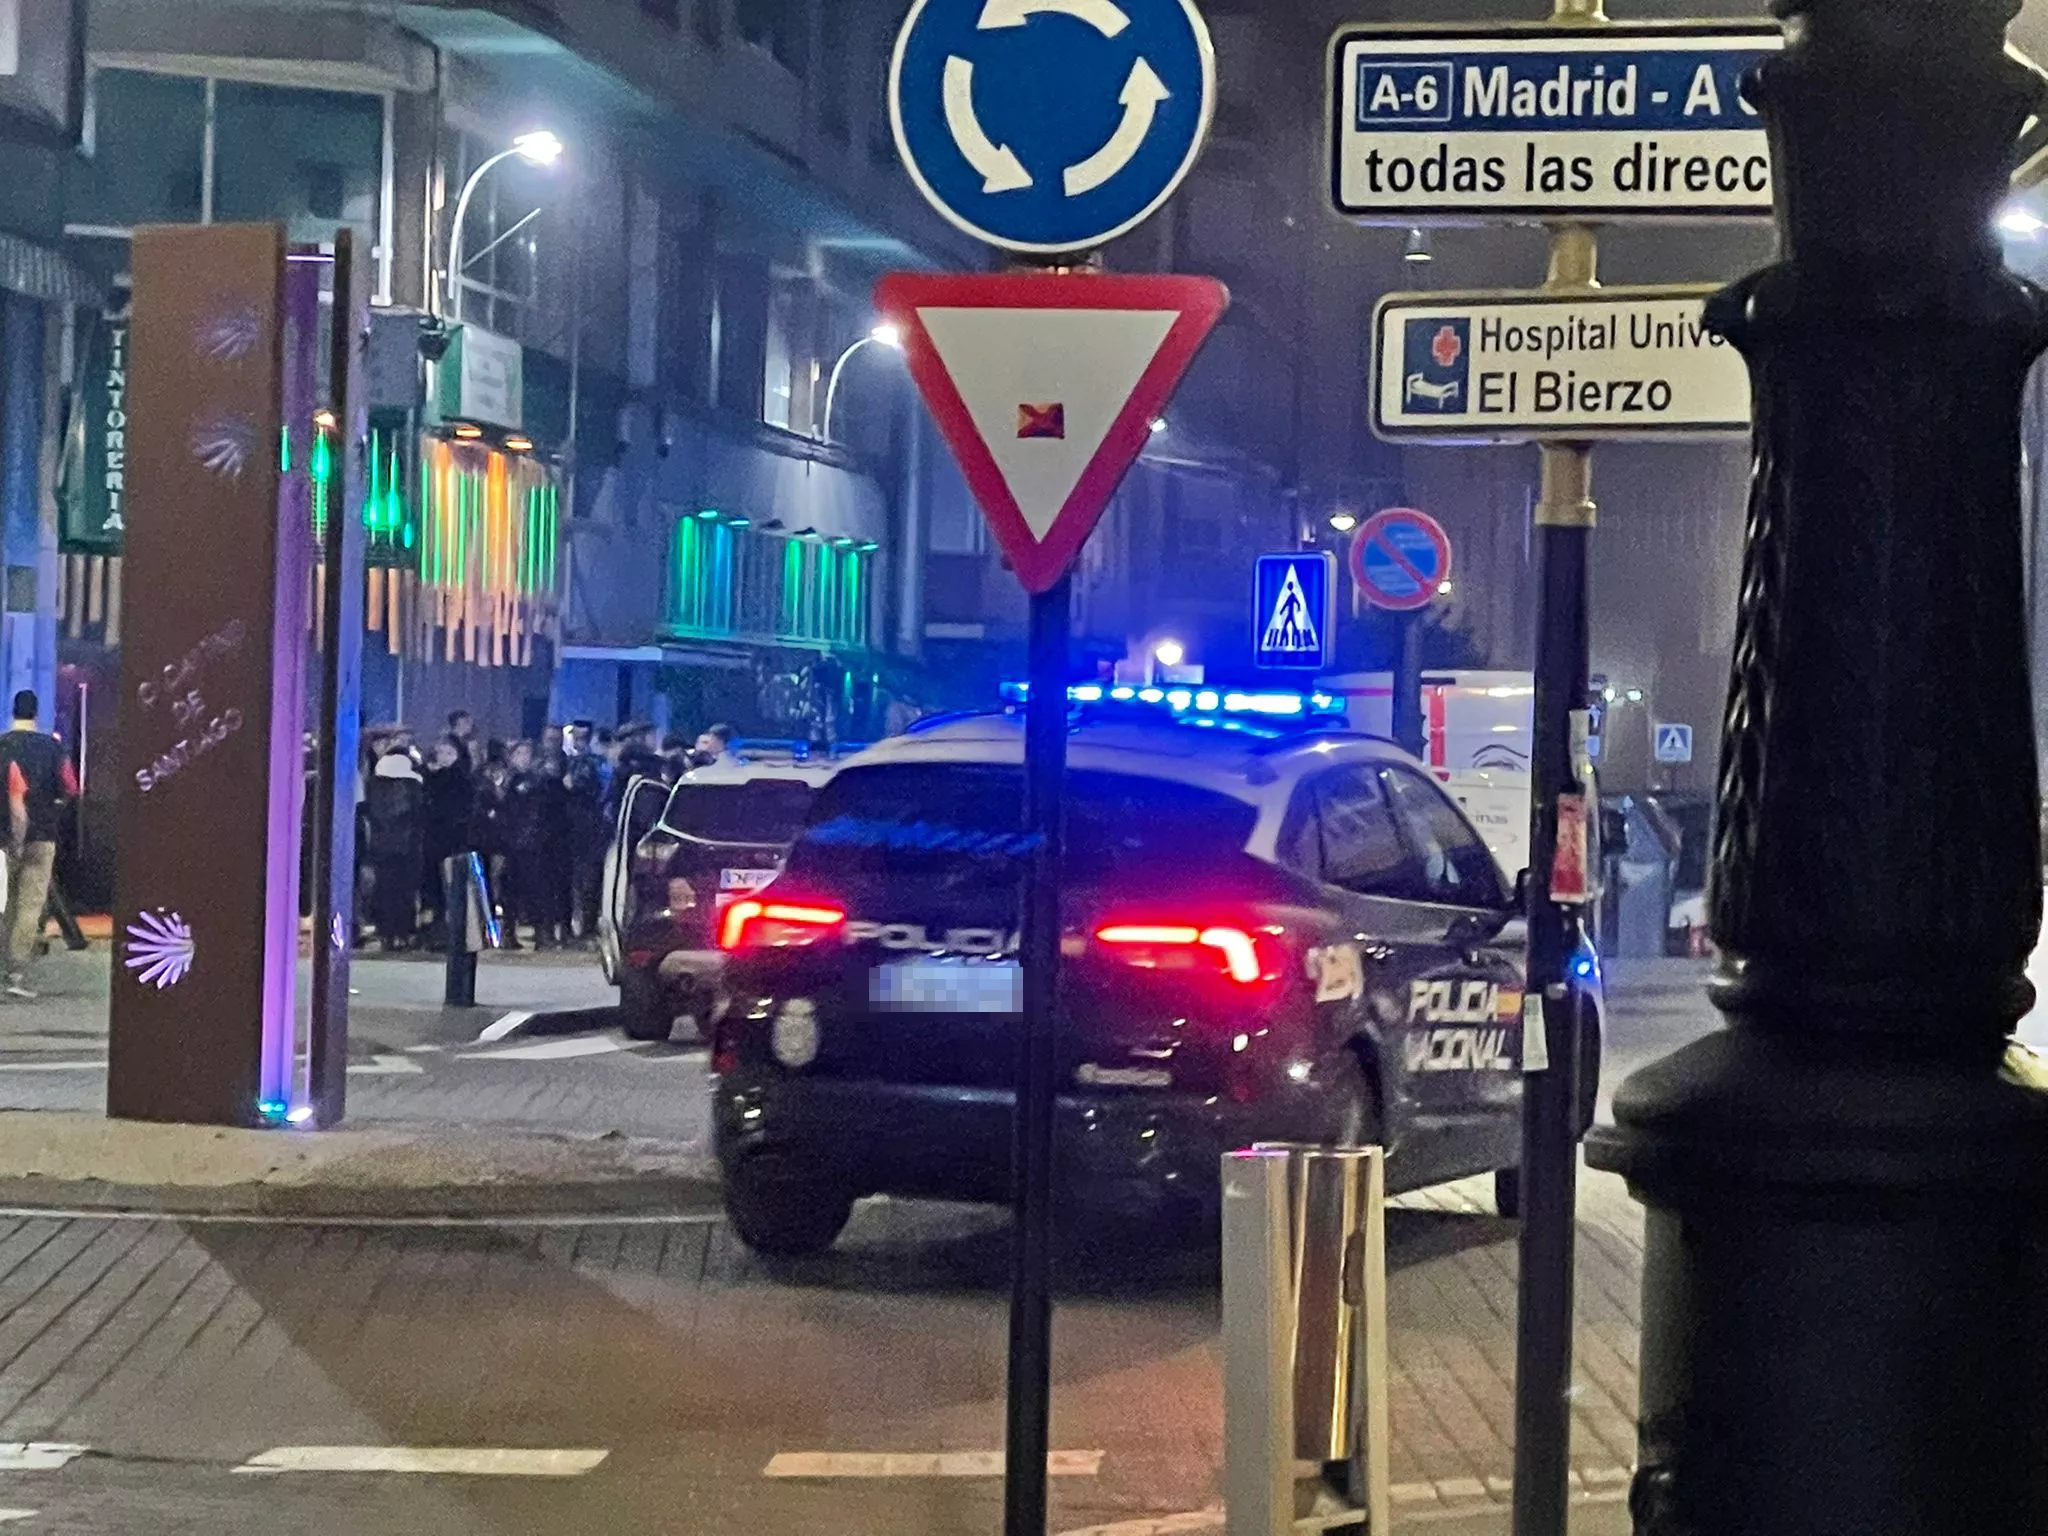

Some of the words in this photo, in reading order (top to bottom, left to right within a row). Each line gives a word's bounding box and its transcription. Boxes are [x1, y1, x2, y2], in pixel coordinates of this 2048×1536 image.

[1370, 73, 1439, 112] A-6
[1463, 64, 1637, 117] Madrid
[1683, 64, 1721, 116] A
[1365, 142, 1506, 193] todas
[1525, 142, 1594, 193] las
[1613, 141, 1768, 193] direcc
[1480, 314, 1616, 360] Hospital
[1630, 311, 1725, 350] Unive
[1478, 371, 1518, 414] El
[1533, 370, 1673, 413] Bierzo
[102, 329, 126, 531] TINTORERIA
